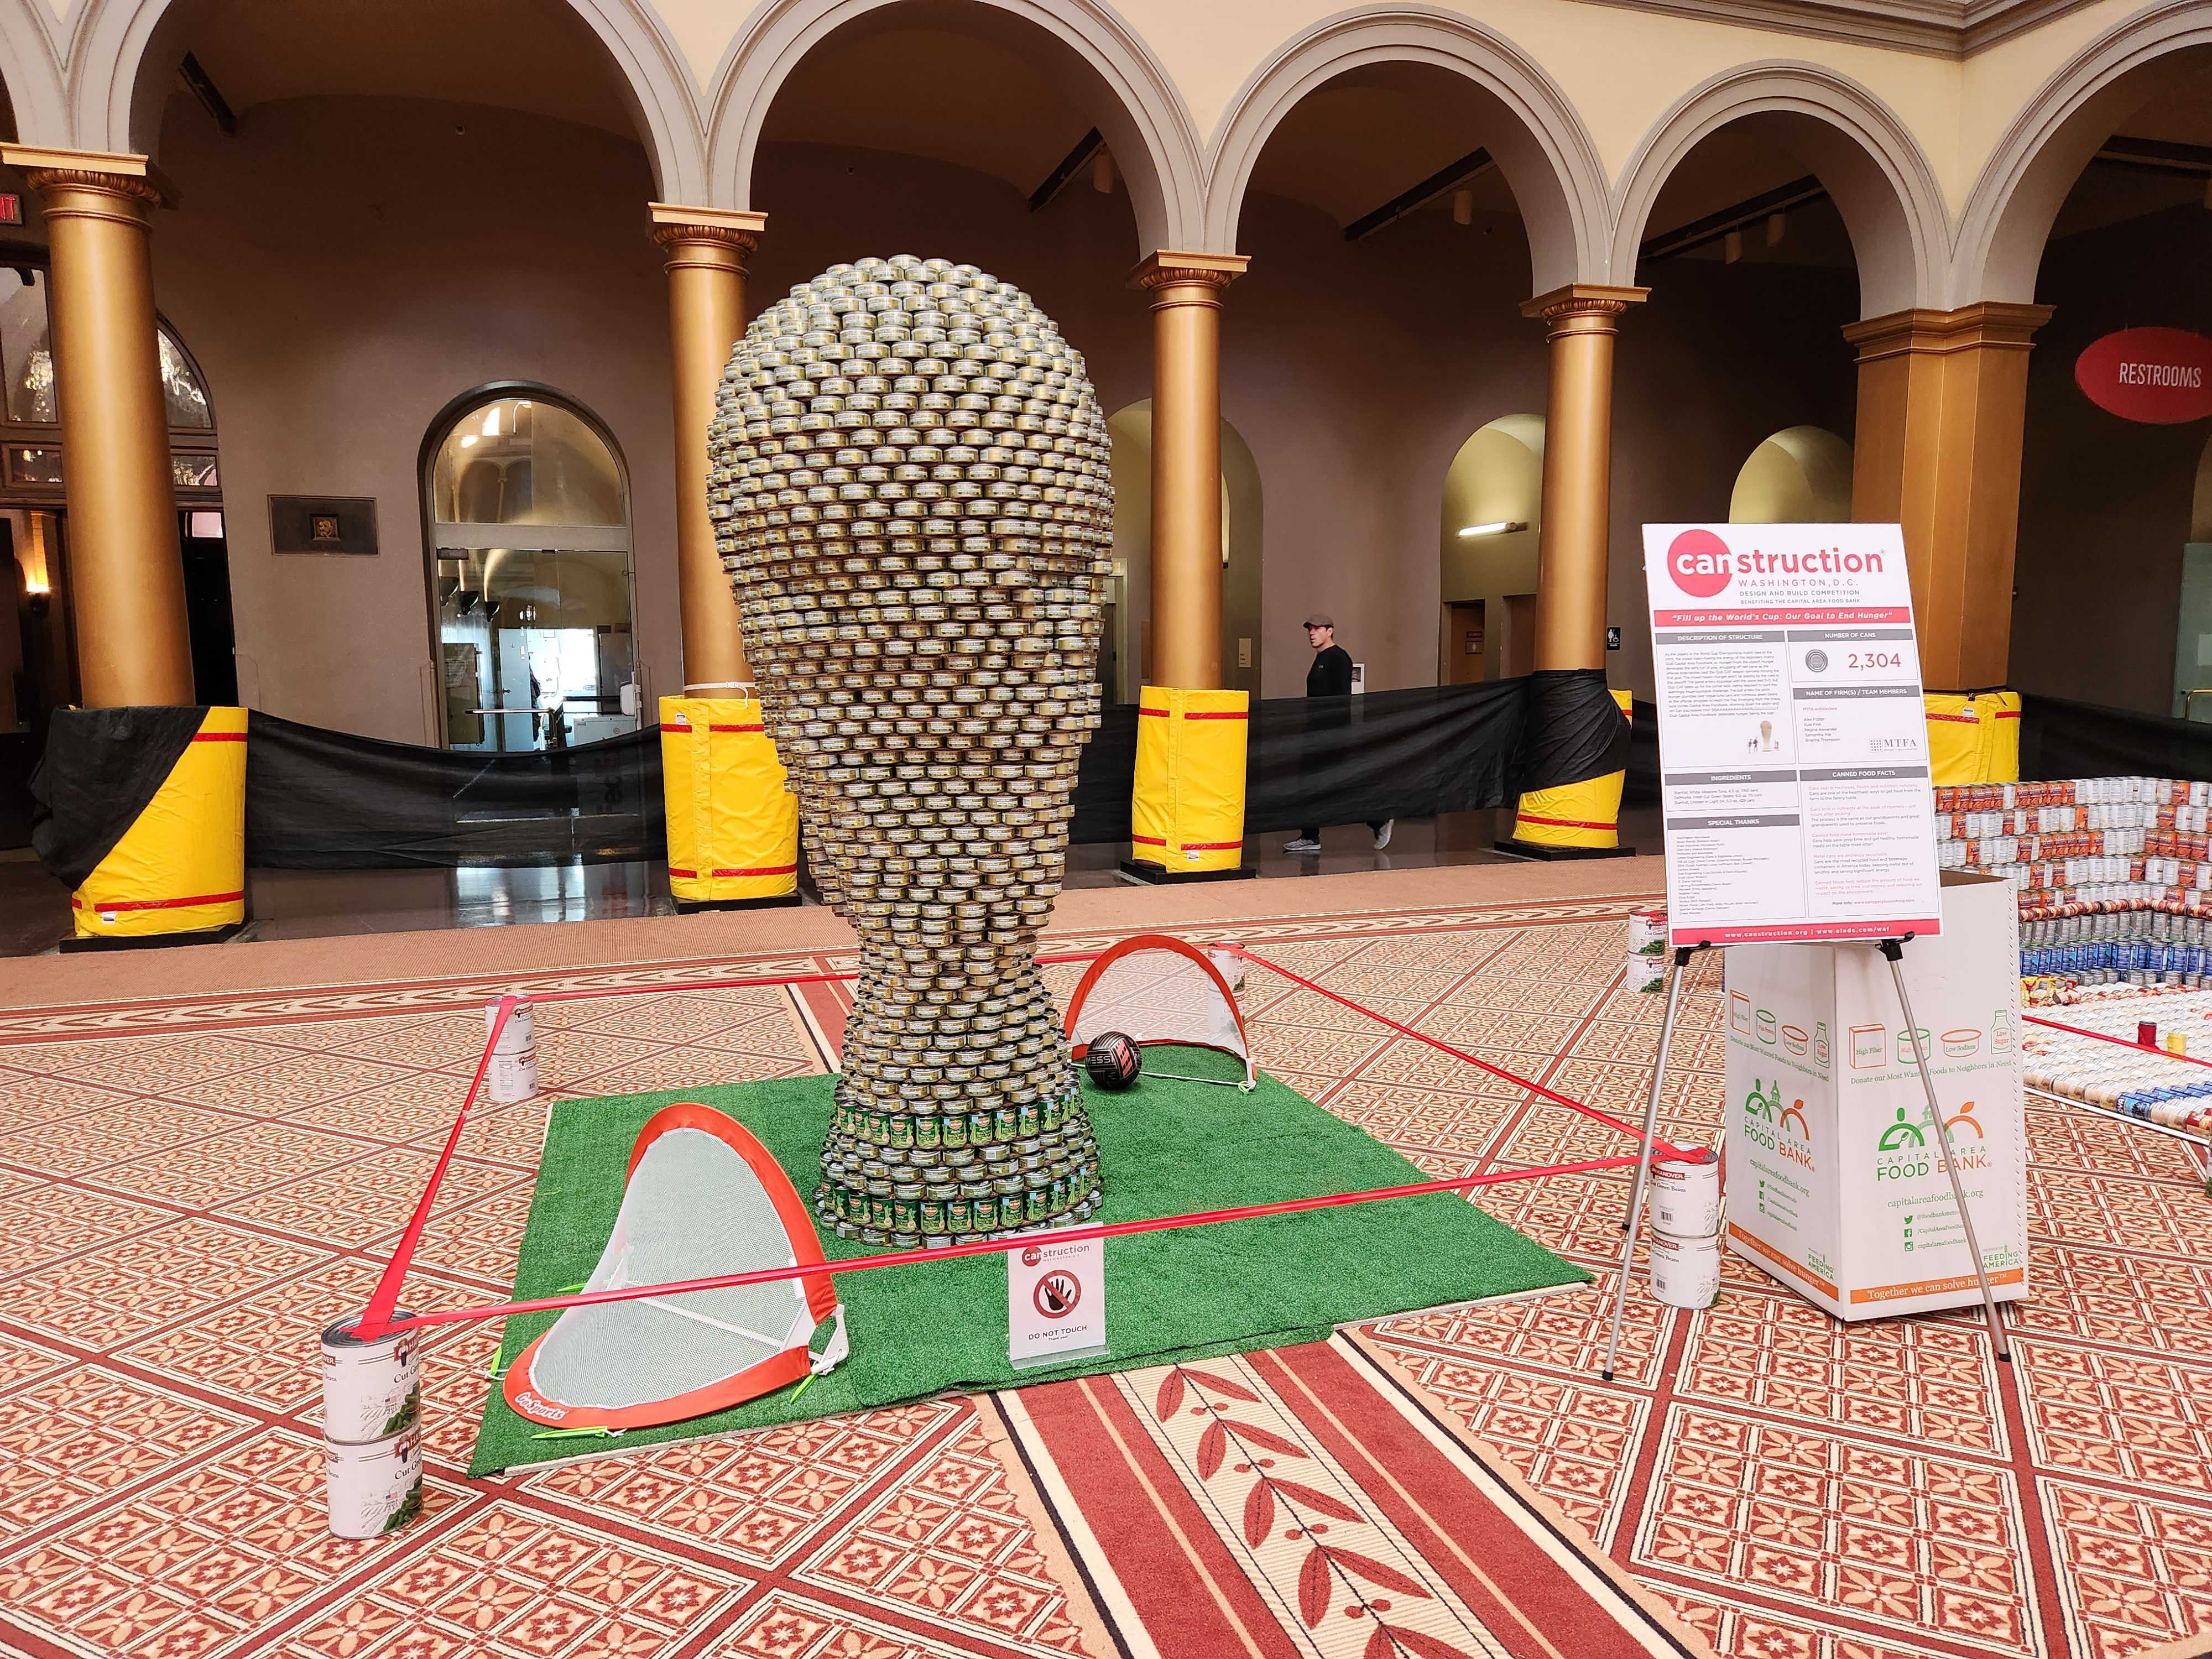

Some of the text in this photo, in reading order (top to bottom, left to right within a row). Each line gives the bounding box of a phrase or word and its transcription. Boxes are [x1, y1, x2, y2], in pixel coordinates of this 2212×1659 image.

[2119, 363, 2201, 388] RESTROOMS
[1849, 653, 1901, 671] 2,304
[1884, 738, 1916, 747] MTFA
[1957, 1063, 1986, 1072] Neighbors
[1744, 1116, 1811, 1155] CAPITAL AREA
[1745, 1124, 1775, 1150] FOOD
[1877, 1146, 1986, 1165] CAPITAL AREA
[1877, 1162, 1929, 1181] FOOD
[1887, 1190, 1984, 1208] capitalareafoodbk.org
[1024, 1244, 1089, 1261] canstruction
[1738, 1229, 1762, 1249] Together
[1771, 1251, 1781, 1262] can
[1782, 1259, 1797, 1272] solve
[1984, 1251, 2018, 1261] FEEDING
[1808, 1254, 1833, 1273] FEEDING
[1808, 1261, 1834, 1280] AMERICA
[1983, 1259, 2018, 1269] AMERICA
[1867, 1288, 1908, 1300] Together
[1943, 1280, 1965, 1290] solve
[1042, 1329, 1058, 1338] NOT
[1061, 1325, 1087, 1335] TOUCH
[394, 1372, 409, 1383] Cut
[395, 1468, 410, 1479] Cut
